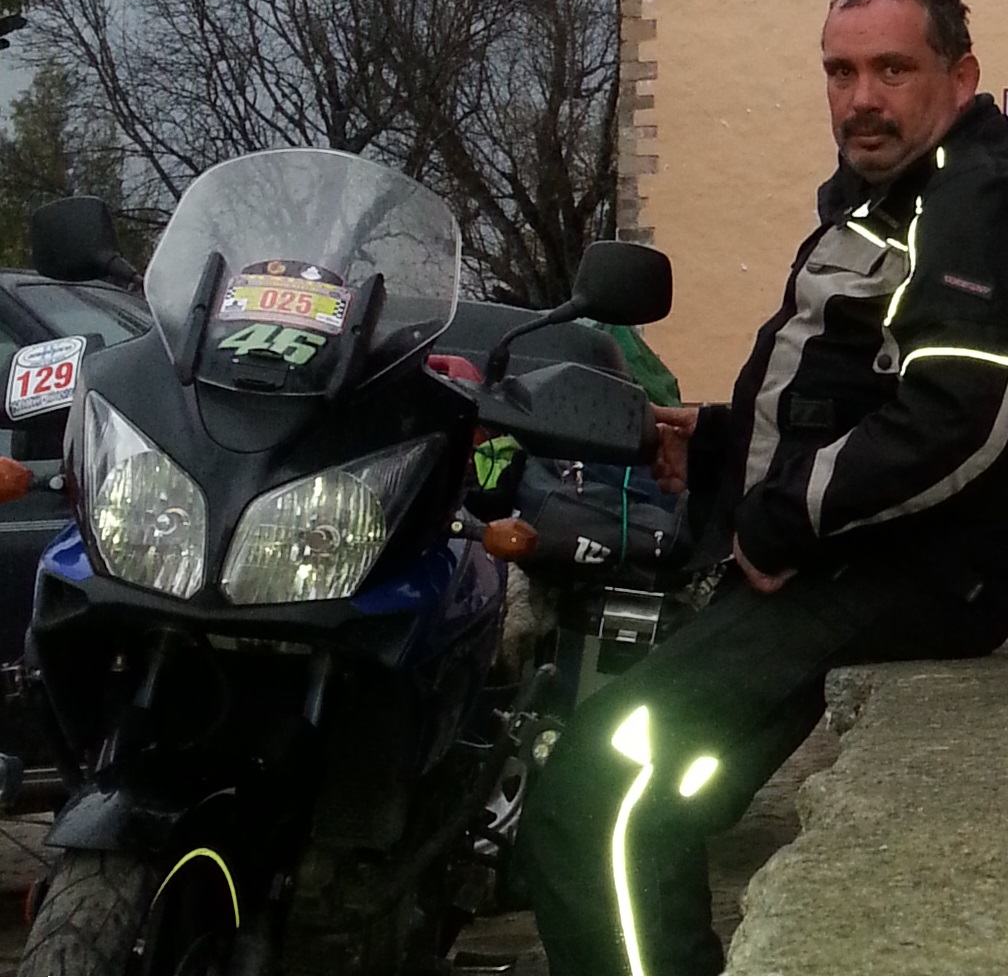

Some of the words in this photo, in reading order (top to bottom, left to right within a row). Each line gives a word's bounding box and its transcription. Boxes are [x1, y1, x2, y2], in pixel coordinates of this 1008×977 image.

[259, 289, 313, 315] 025
[217, 323, 327, 365] 46
[17, 361, 74, 398] 129
